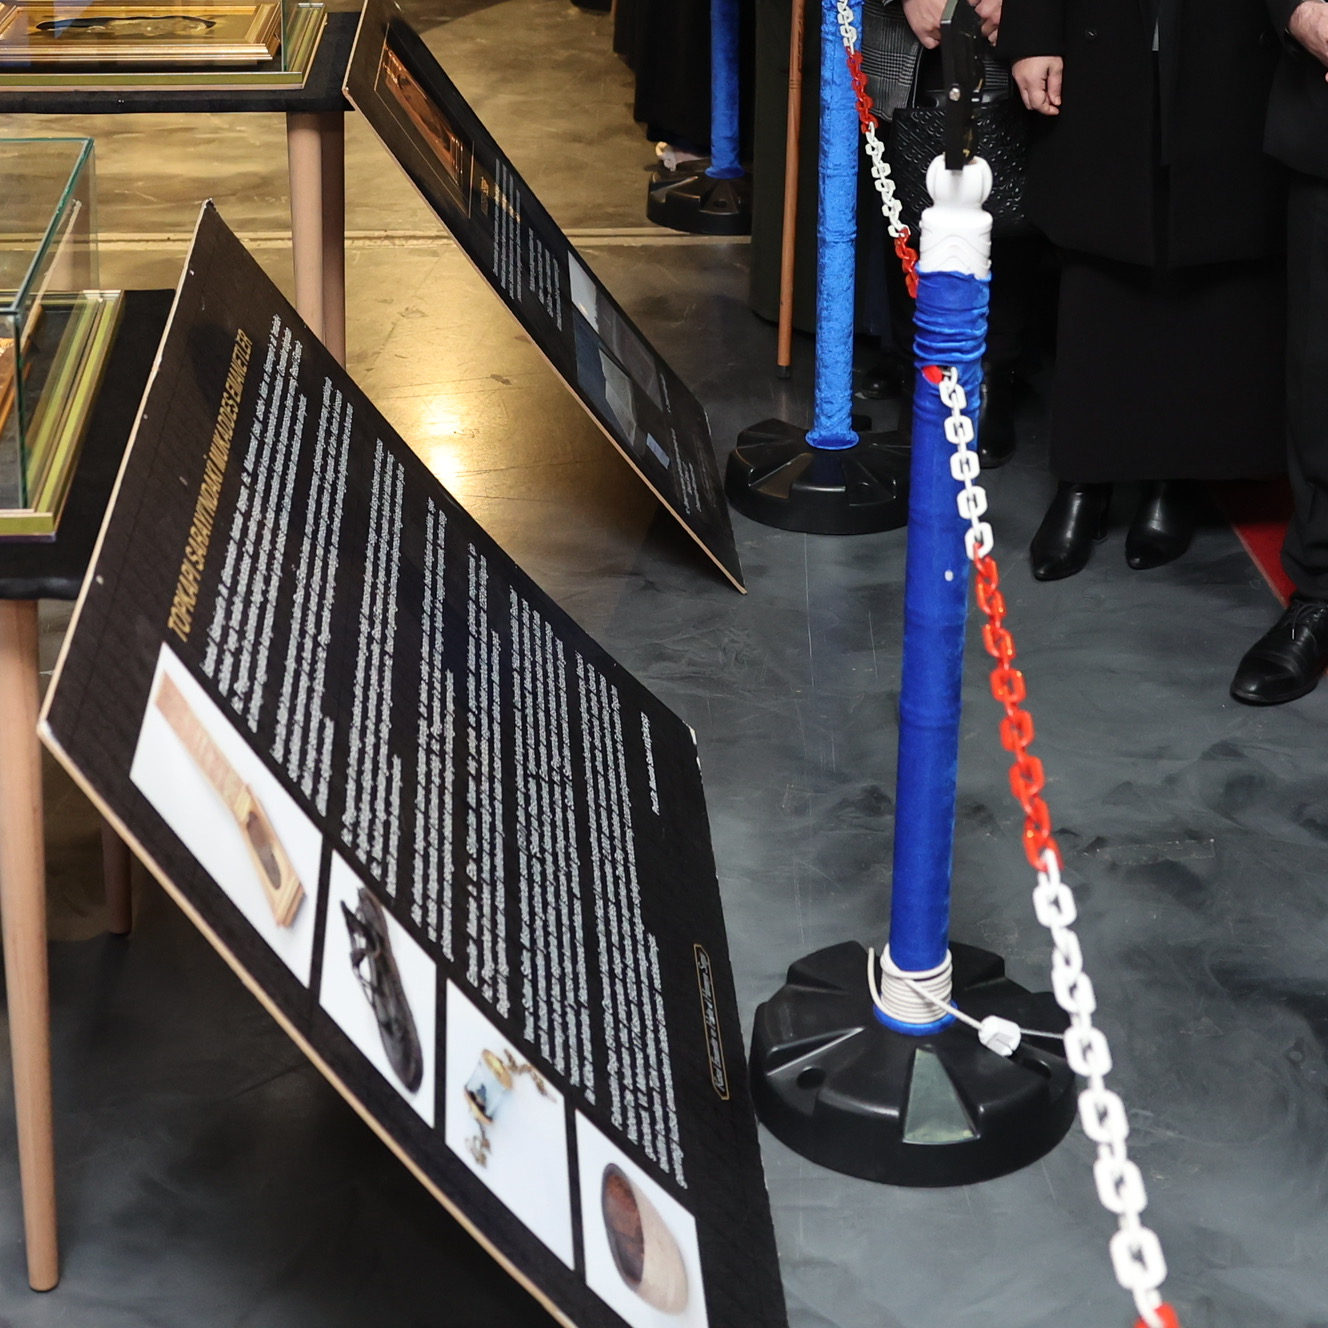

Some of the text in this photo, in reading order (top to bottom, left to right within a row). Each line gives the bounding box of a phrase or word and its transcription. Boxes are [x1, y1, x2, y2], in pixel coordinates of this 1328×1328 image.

[167, 328, 253, 643] TOPKAPI SARAYI'NDAKİ MUKADDES EMANETLER
